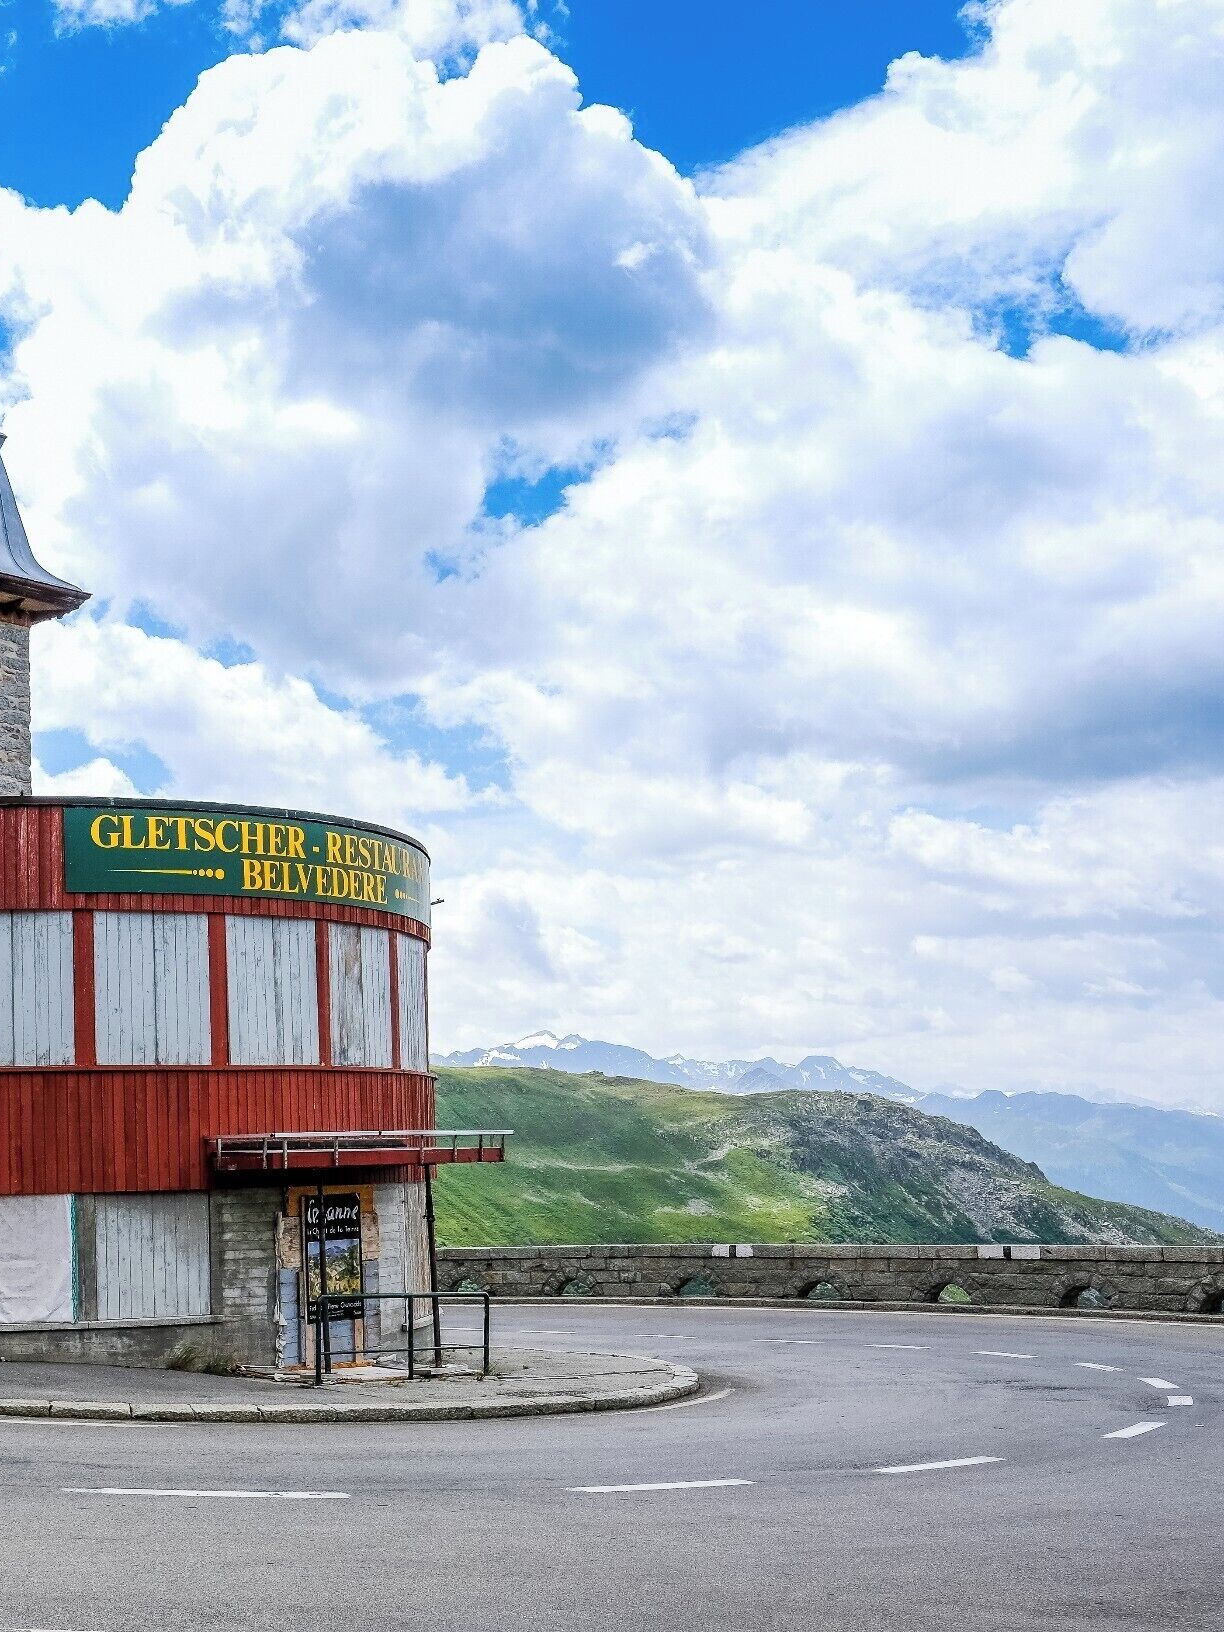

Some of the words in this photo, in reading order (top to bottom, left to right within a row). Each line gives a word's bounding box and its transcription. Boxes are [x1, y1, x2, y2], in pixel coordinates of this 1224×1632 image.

[90, 814, 306, 858] GLETSCHER
[325, 831, 426, 885] RESTAURA
[240, 858, 388, 905] BELVEDERE
